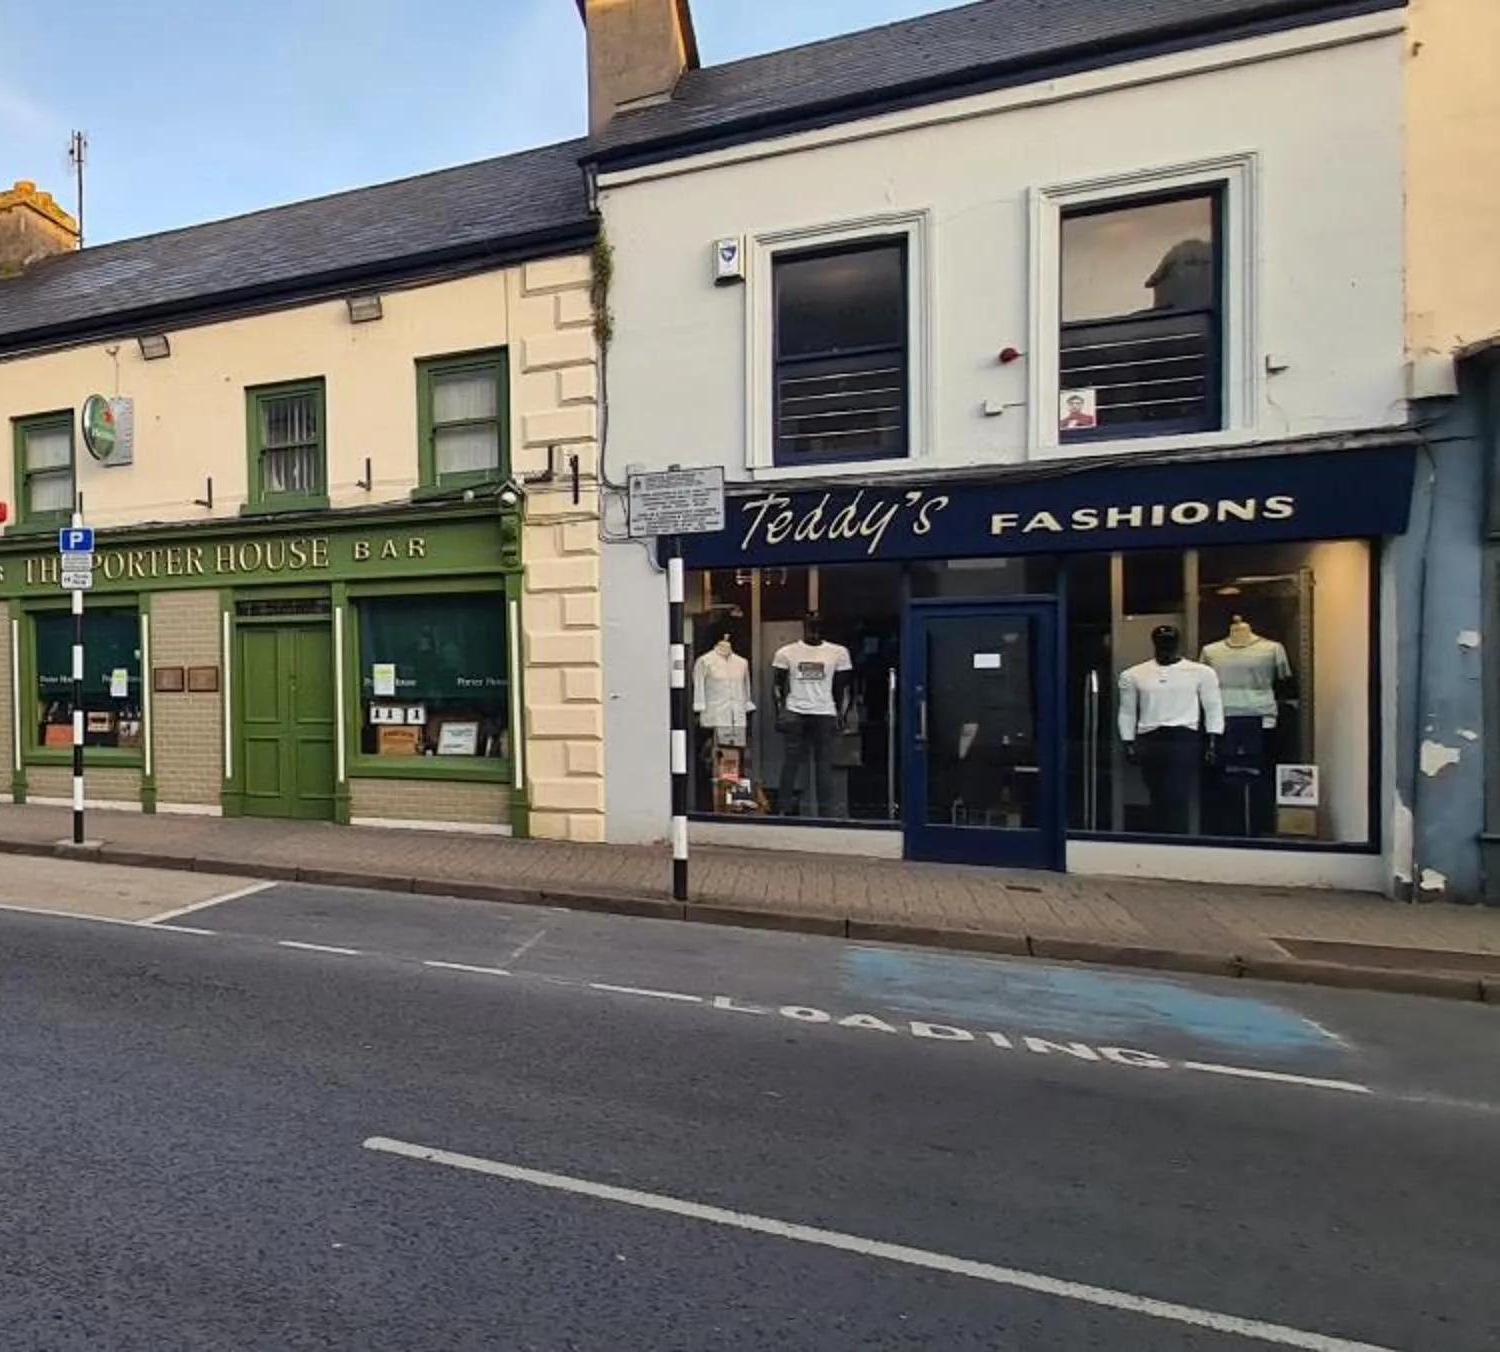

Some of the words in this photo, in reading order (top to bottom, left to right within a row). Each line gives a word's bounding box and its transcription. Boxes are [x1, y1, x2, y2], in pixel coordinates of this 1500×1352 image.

[741, 490, 949, 552] Teddy's
[990, 496, 1295, 535] FASHIONS
[26, 557, 59, 583] TH
[215, 537, 330, 574] HOUSE
[354, 537, 426, 562] BAR
[70, 531, 84, 549] P
[712, 995, 1170, 1068] LOADING
